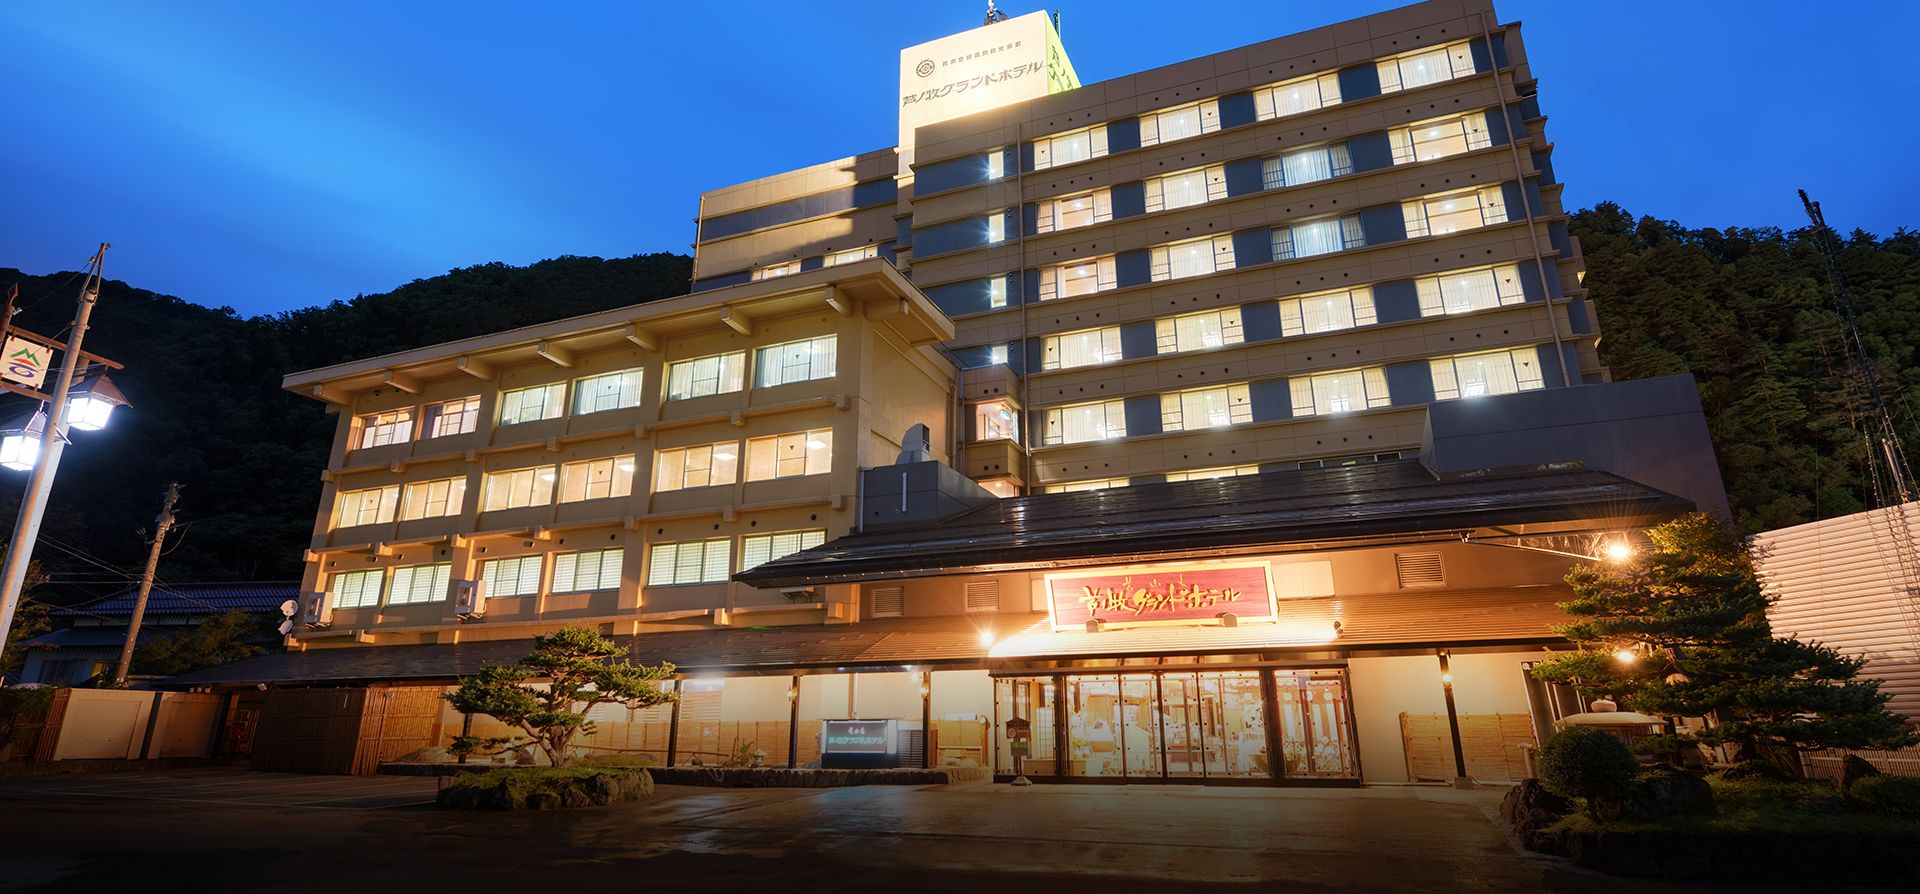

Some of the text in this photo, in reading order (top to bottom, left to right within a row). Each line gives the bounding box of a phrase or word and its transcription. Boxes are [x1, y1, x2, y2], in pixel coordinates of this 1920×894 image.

[902, 60, 1043, 107] 芦ノ牧グランドホテル
